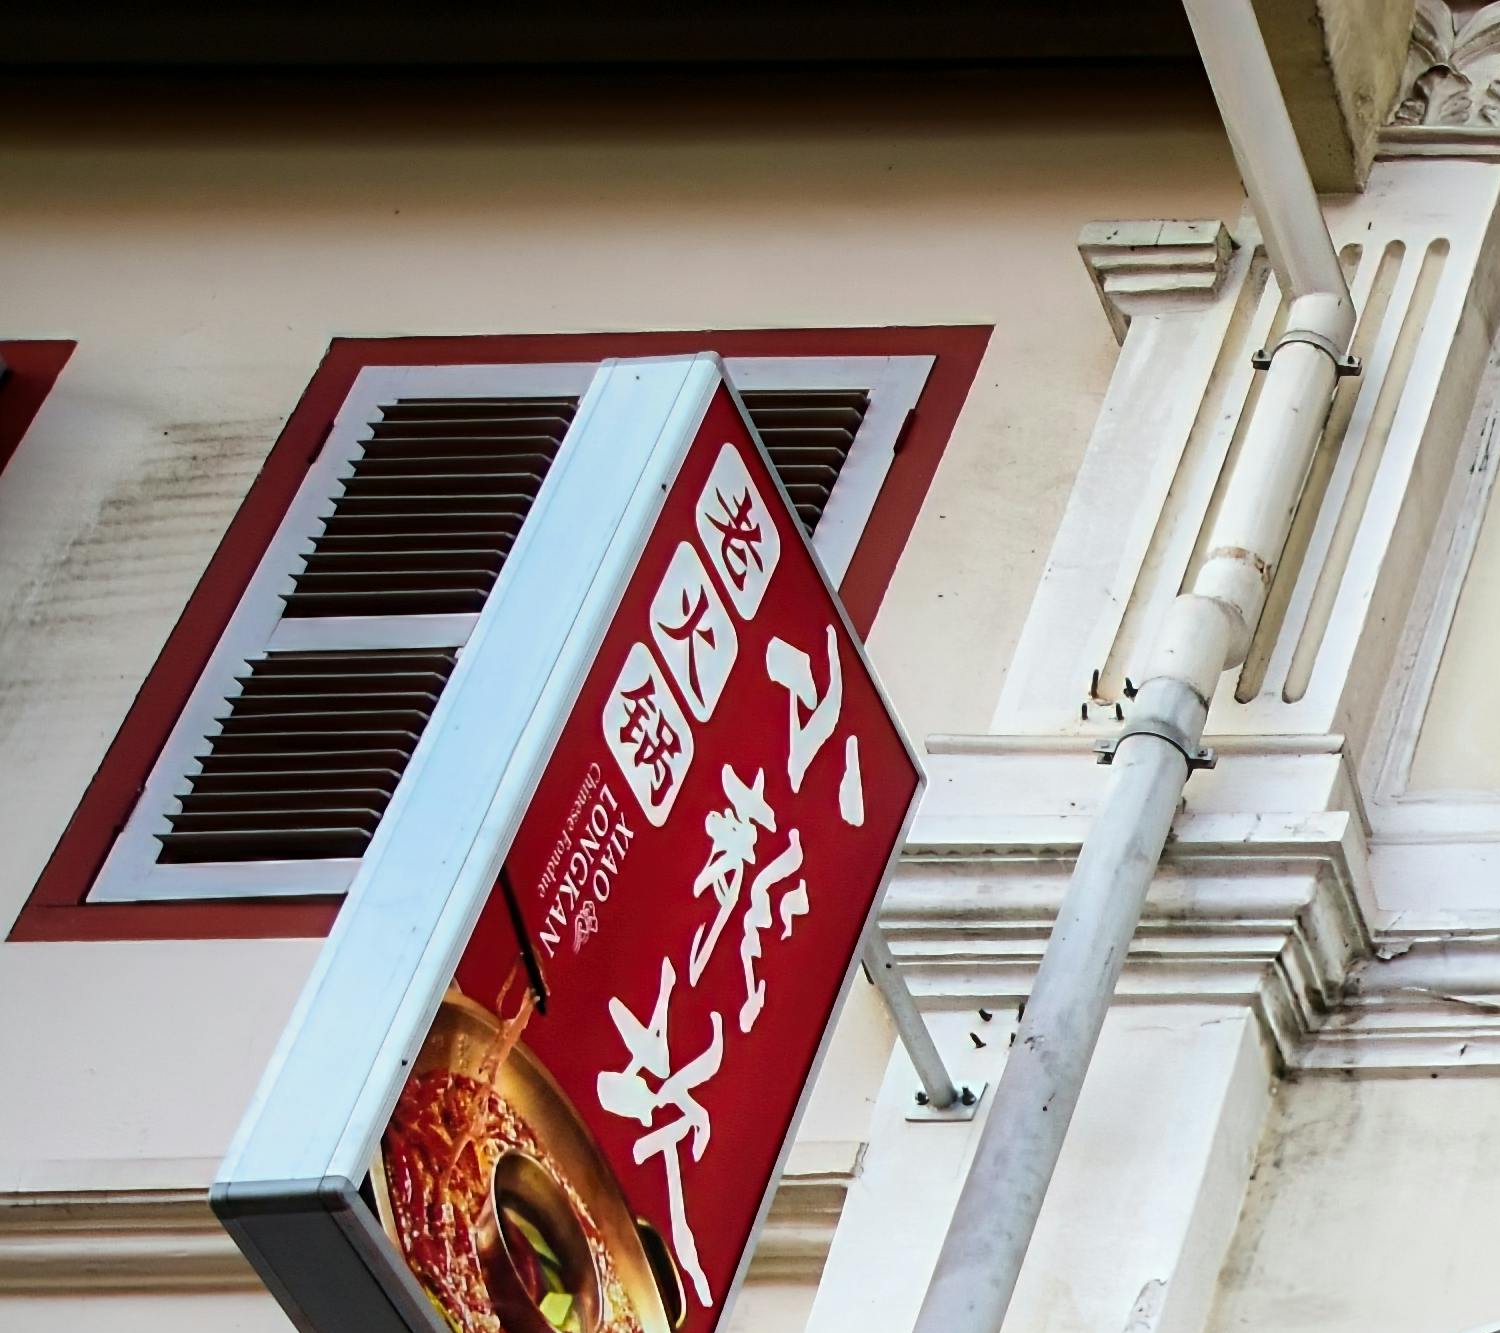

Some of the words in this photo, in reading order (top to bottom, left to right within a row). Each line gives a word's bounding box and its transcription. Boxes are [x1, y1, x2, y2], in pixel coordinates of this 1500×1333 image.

[566, 761, 601, 831] Chinese
[536, 829, 573, 898] Fondue
[539, 783, 618, 958] LONGKAN
[592, 811, 635, 902] XIAO
